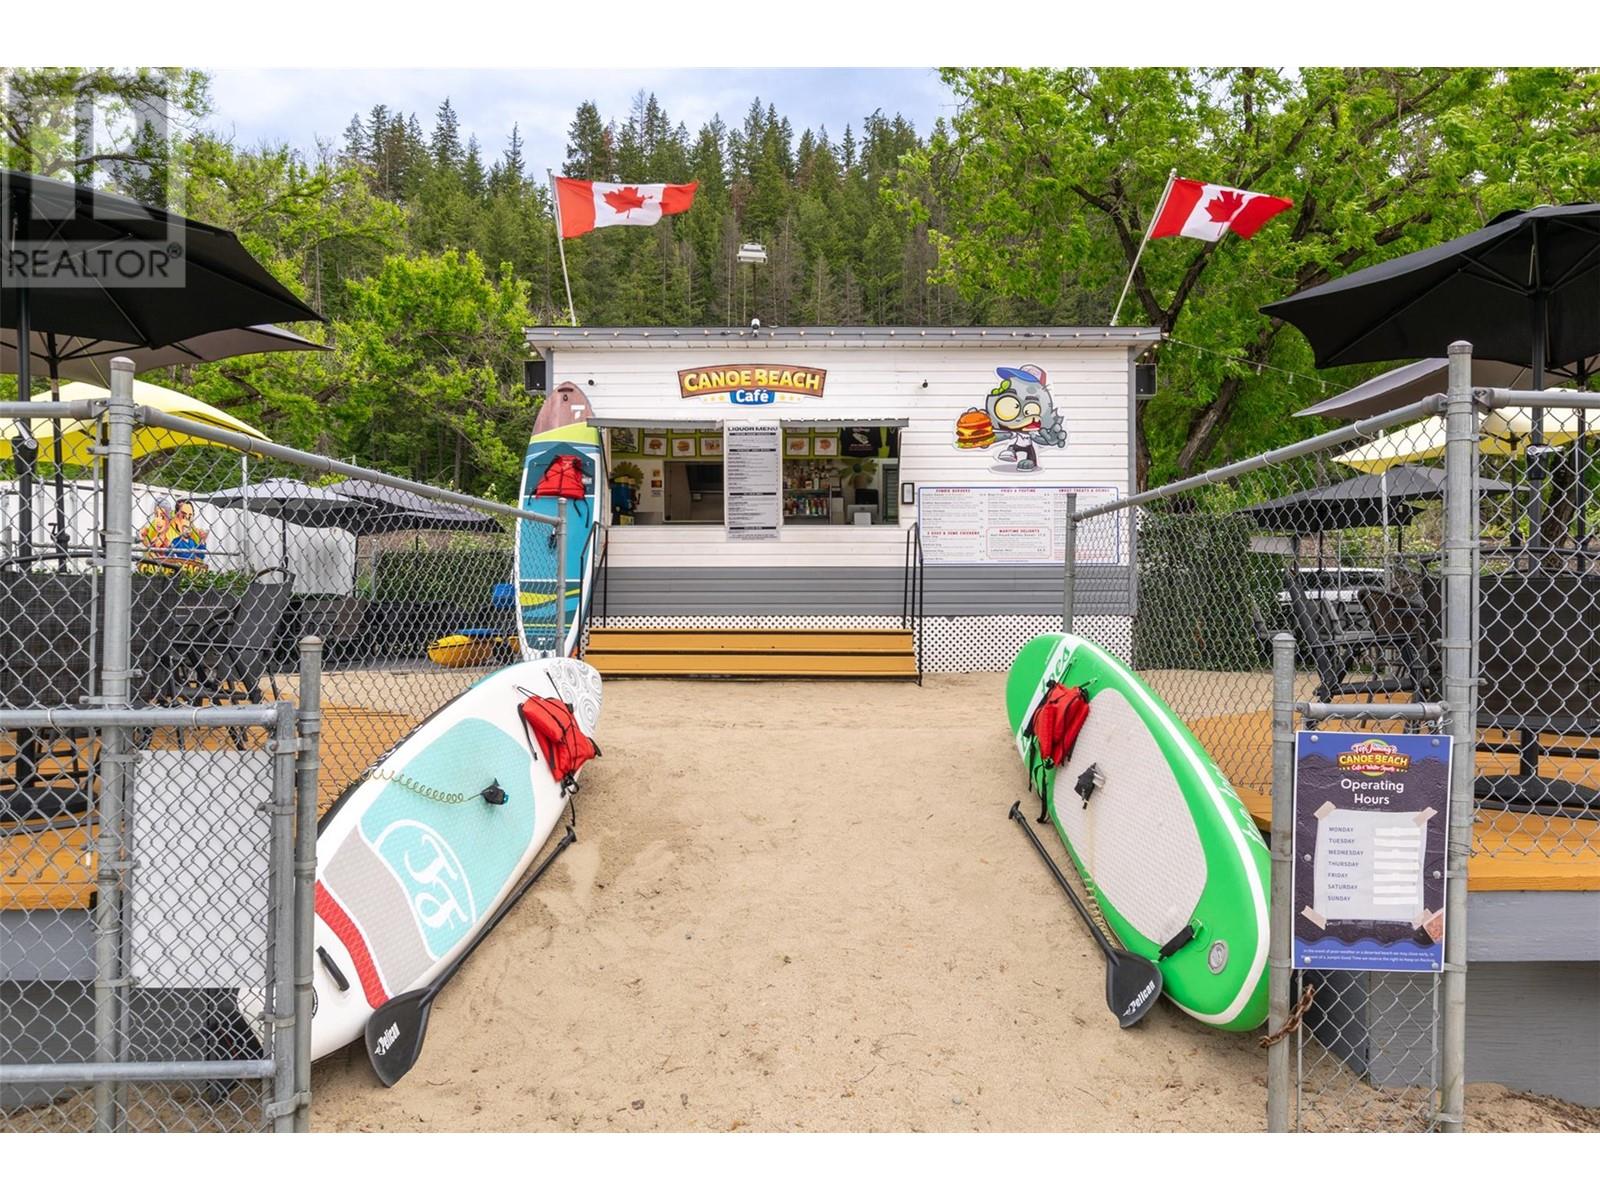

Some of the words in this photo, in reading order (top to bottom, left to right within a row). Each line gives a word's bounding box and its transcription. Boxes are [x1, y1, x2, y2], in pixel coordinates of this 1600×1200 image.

[683, 369, 751, 392] CANOE
[755, 368, 821, 391] BEACH
[735, 389, 769, 403] Café
[1339, 754, 1374, 765] CANOE
[1375, 754, 1408, 766] BEACH
[1341, 778, 1404, 794] Operating
[1354, 793, 1390, 805] Hours
[1130, 980, 1156, 1013] Pelican
[378, 1021, 400, 1055] Pelican
